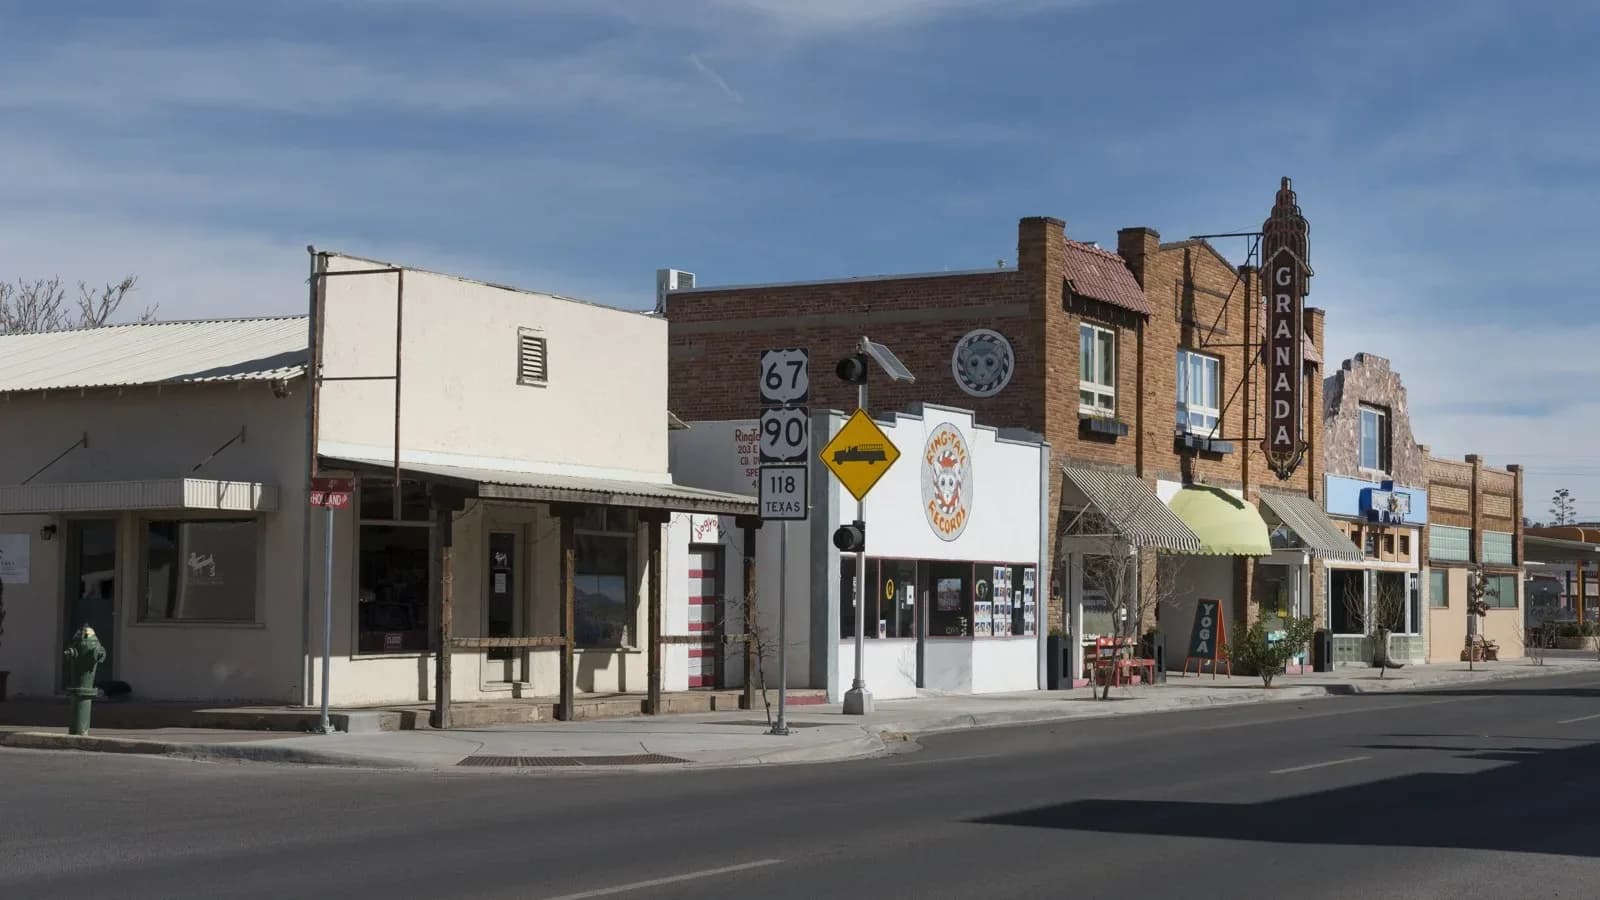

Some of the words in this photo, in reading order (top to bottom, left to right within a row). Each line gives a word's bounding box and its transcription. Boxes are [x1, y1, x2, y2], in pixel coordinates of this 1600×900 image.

[1274, 267, 1292, 445] GRANADA
[765, 361, 803, 390] 67
[765, 418, 803, 447] 90
[738, 446, 751, 454] 203
[926, 431, 967, 468] RING-TAIL
[746, 469, 759, 477] SPE
[771, 476, 795, 493] 118
[766, 502, 800, 512] TEXAS
[928, 501, 966, 534] RECORDS
[1196, 603, 1215, 653] YOGA
